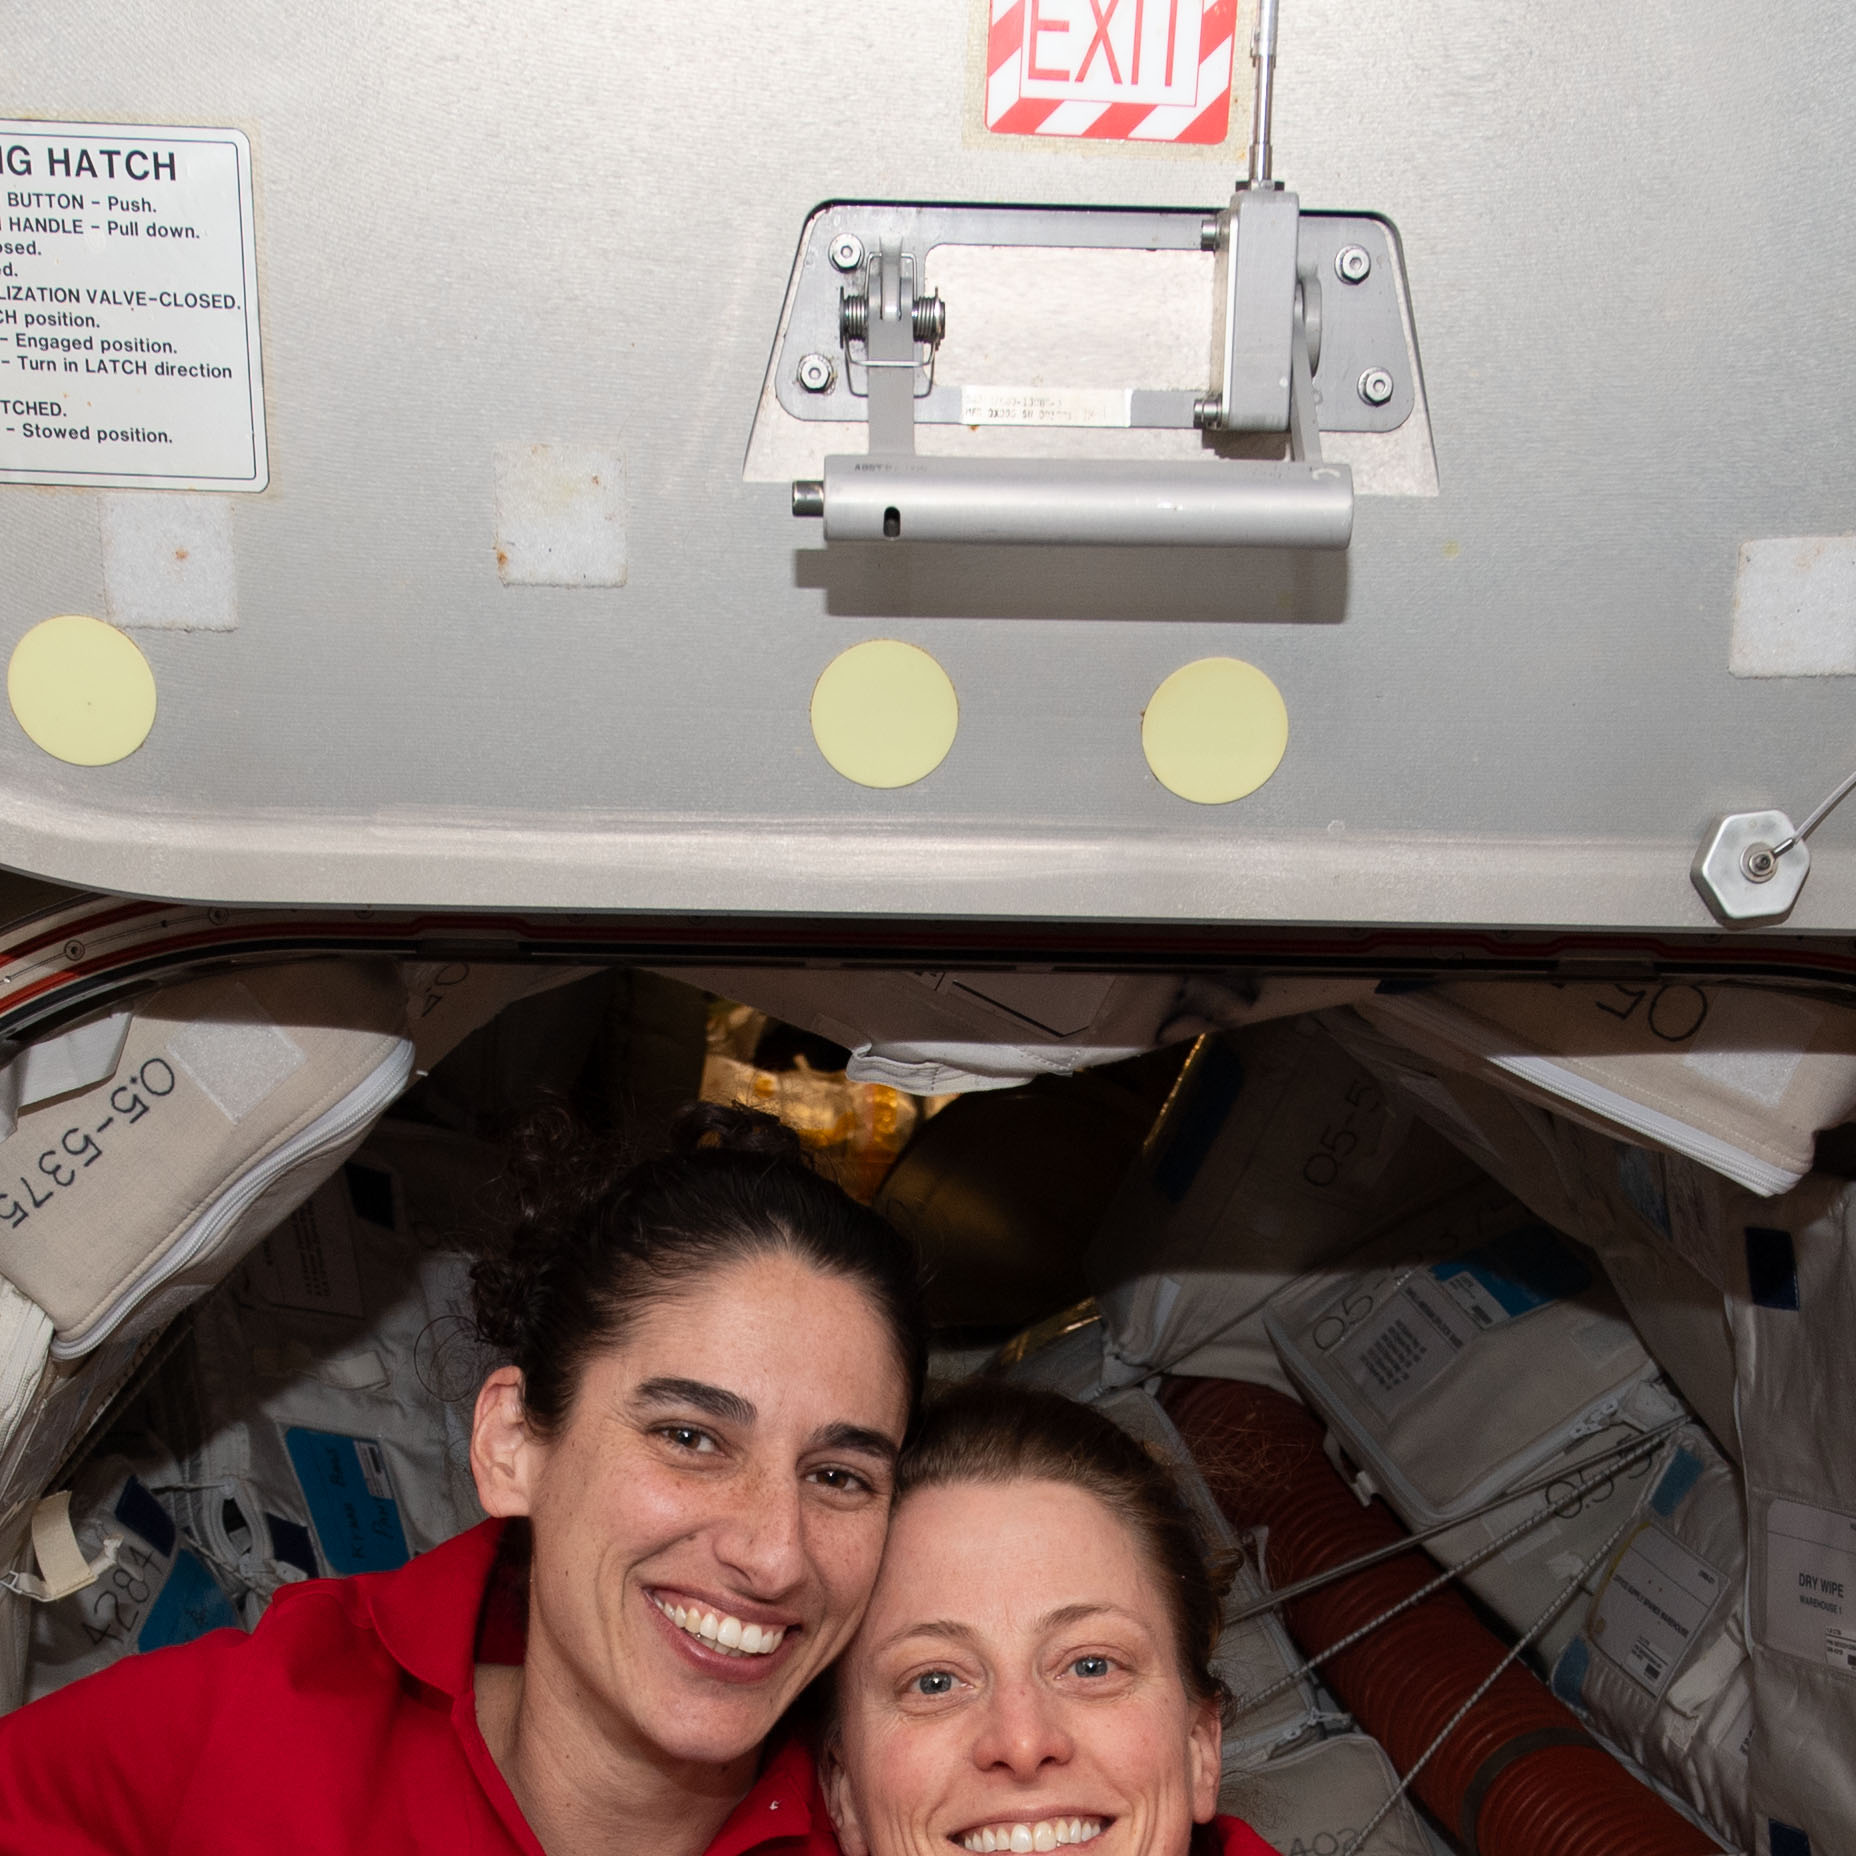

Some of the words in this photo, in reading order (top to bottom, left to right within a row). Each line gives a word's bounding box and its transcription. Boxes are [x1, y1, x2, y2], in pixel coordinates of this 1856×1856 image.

[48, 148, 176, 181] HATCH
[7, 192, 83, 210] BUTTON
[108, 196, 157, 213] Push.
[8, 216, 83, 234] HANDLE
[108, 222, 139, 237] Pull
[146, 223, 200, 239] down.
[87, 290, 241, 310] VALVE-CLOSED.
[24, 312, 100, 328] position.
[16, 332, 93, 352] Engaged
[100, 339, 177, 355] position.
[17, 355, 57, 372] Turn
[64, 358, 78, 373] in
[85, 358, 147, 375] LATCH
[153, 360, 232, 379] direction
[23, 424, 90, 441] Stowed
[97, 426, 173, 443] position.
[81, 1545, 164, 1646] 4284
[1798, 1572, 1819, 1589] DRY
[1820, 1578, 1844, 1598] WIPE
[1799, 1595, 1836, 1614] WAREHOUSE
